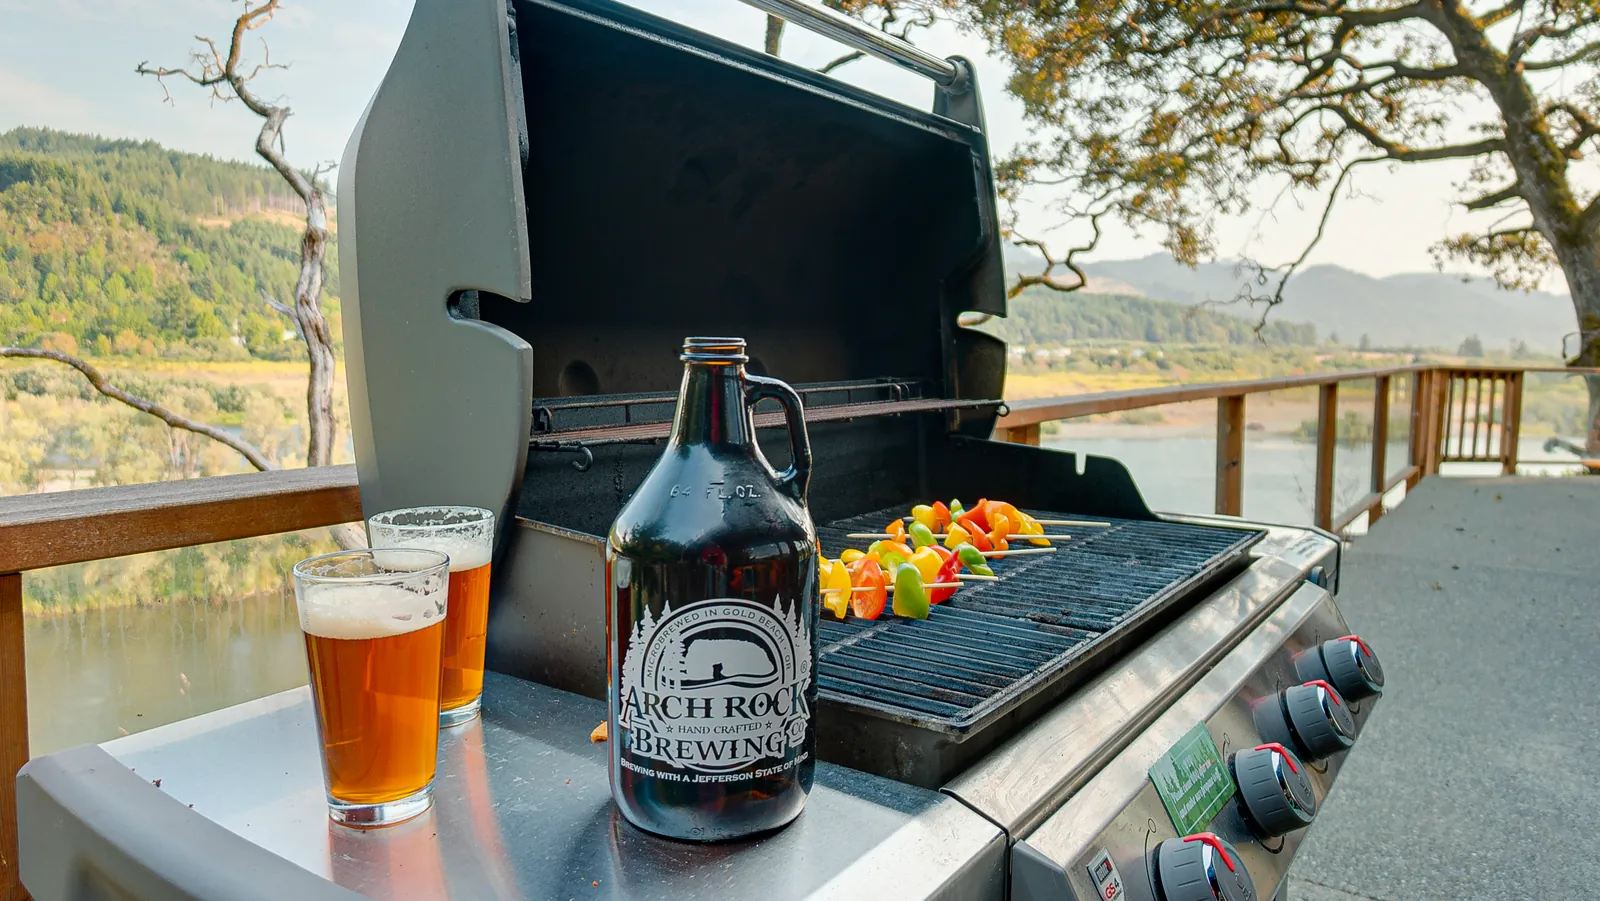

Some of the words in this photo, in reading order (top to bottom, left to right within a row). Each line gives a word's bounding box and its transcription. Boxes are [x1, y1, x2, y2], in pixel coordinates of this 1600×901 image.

[670, 485, 692, 498] 64
[647, 612, 700, 678] MICROBREWED
[705, 608, 718, 618] IN
[723, 607, 756, 620] GOLD
[758, 616, 785, 645] BEACH
[620, 685, 715, 724] ARCH
[723, 678, 808, 721] ROCK
[678, 725, 710, 735] HAND
[713, 721, 762, 735] CRAFTED
[633, 726, 783, 763] BREWING
[620, 757, 655, 778] BREWING
[655, 770, 681, 782] WITH
[682, 774, 691, 783] A
[692, 771, 753, 783] JEFFERSON
[755, 765, 783, 778] STATE
[784, 760, 794, 770] OF
